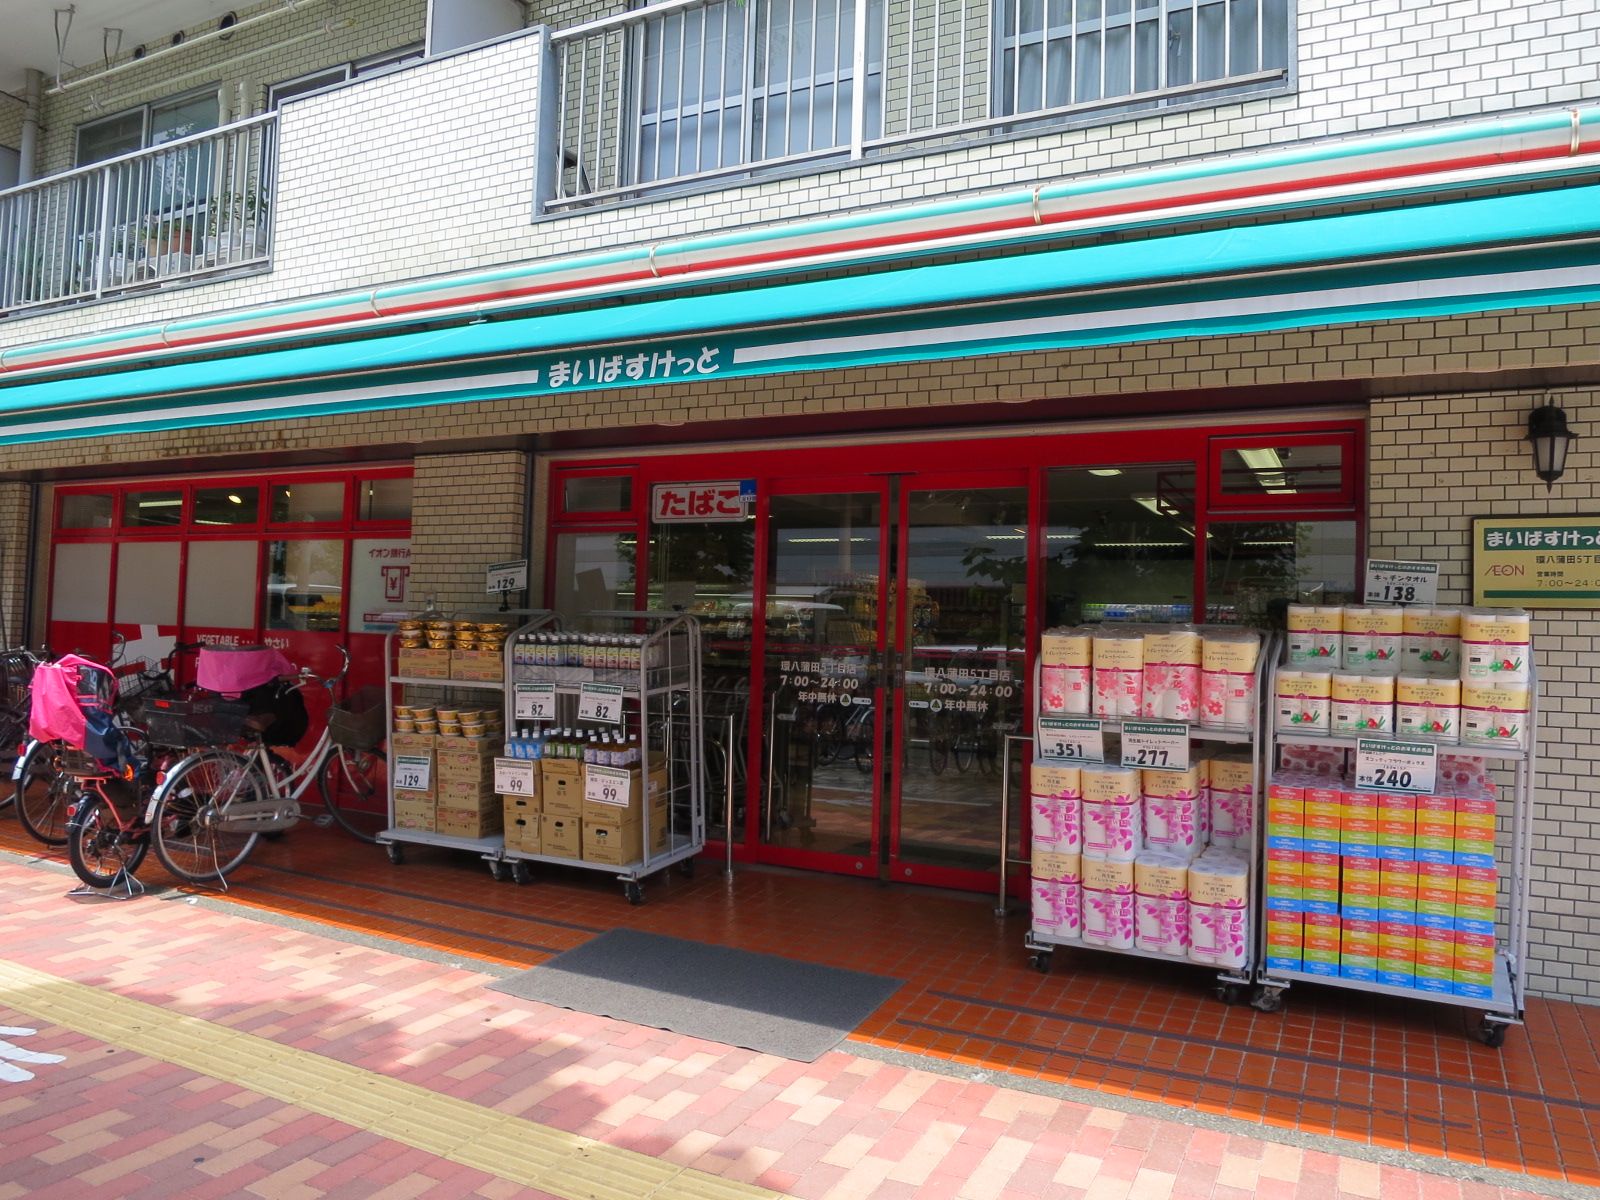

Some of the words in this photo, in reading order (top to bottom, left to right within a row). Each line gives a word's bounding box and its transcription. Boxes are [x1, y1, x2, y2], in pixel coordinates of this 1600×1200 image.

[548, 346, 720, 388] まいばすけっと
[660, 489, 741, 516] たばこ
[497, 577, 515, 589] 129
[1373, 574, 1428, 583] キッチンタオル
[1384, 585, 1416, 602] 138
[780, 660, 857, 675] 環八蒲田5丁目店
[924, 666, 1012, 681] 環八蒲田5丁目店
[798, 690, 837, 704] 年中無休
[531, 704, 544, 717] 82
[595, 705, 609, 718] 82
[944, 699, 989, 713] 年中無休
[1056, 742, 1082, 758] 351
[1137, 749, 1169, 766] 277
[403, 774, 419, 787] 129
[1374, 768, 1412, 788] 240
[510, 779, 523, 792] 99
[602, 787, 617, 800] 99
